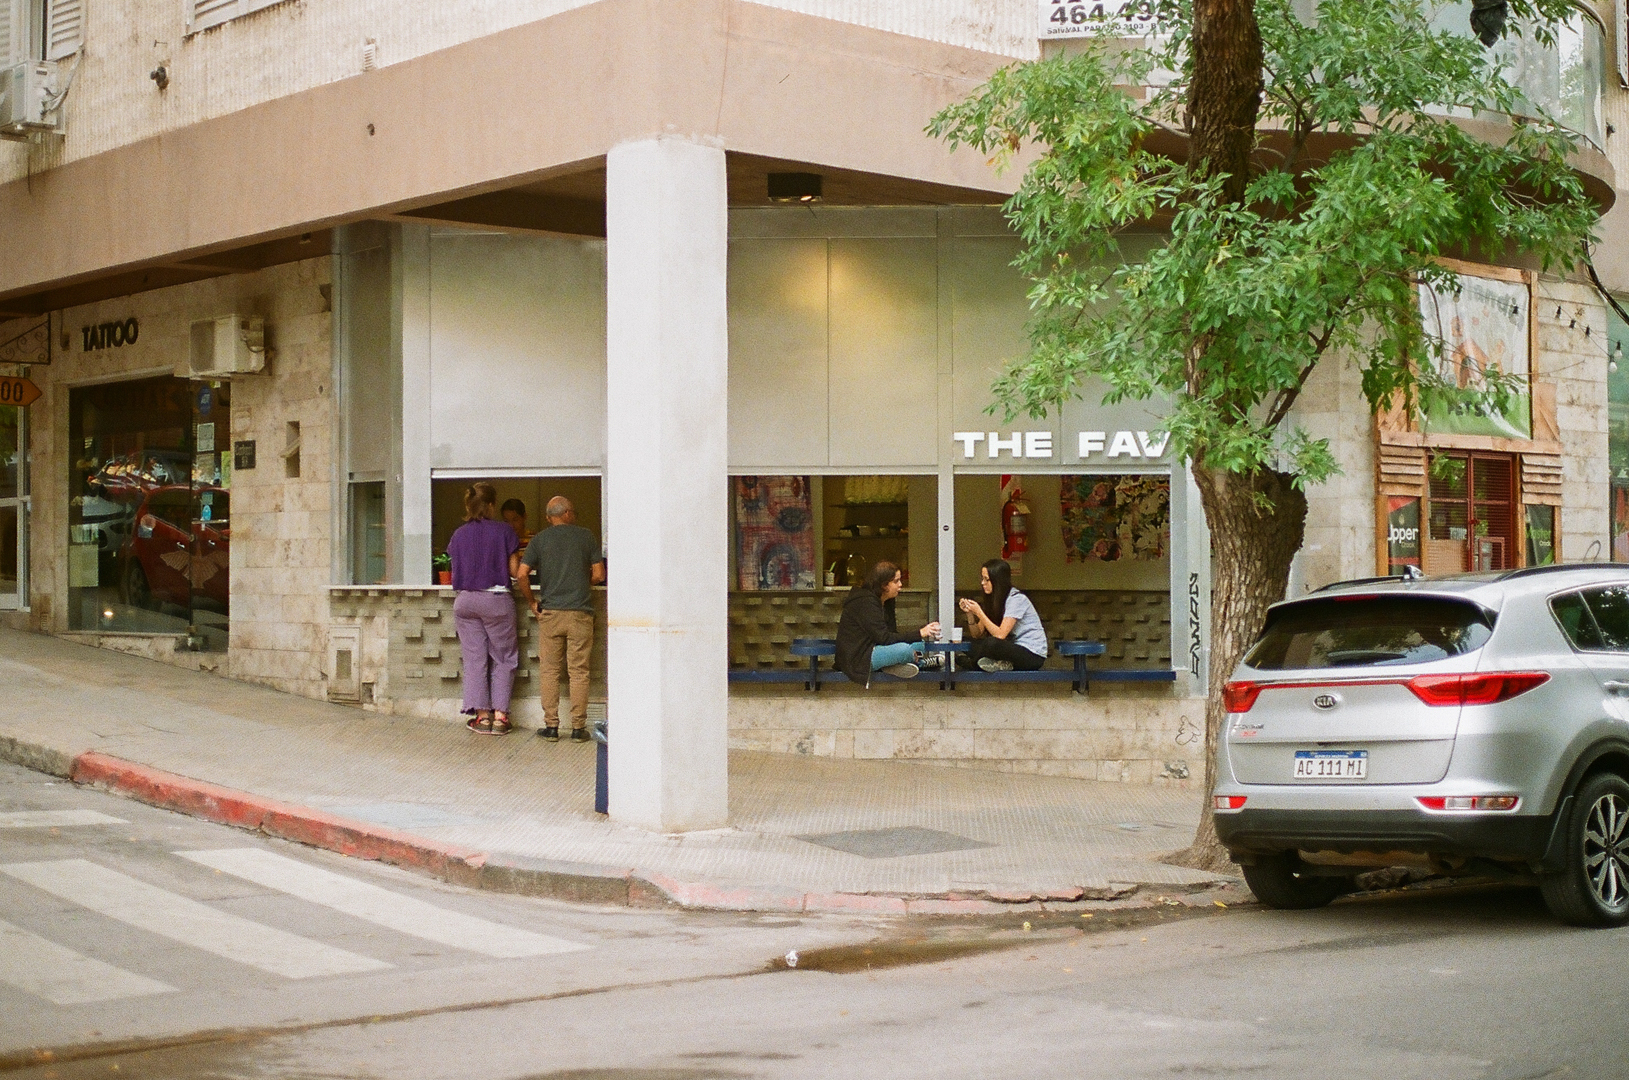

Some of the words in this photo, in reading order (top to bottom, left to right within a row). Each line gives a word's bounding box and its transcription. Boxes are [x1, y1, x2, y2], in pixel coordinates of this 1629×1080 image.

[1050, 3, 1104, 25] 464
[82, 317, 139, 352] TATTOO
[953, 431, 1053, 458] THE
[1078, 431, 1171, 458] FAV
[1316, 697, 1334, 706] KIA
[1297, 760, 1313, 775] AC
[1318, 760, 1342, 775] 111
[1347, 760, 1362, 775] MI
